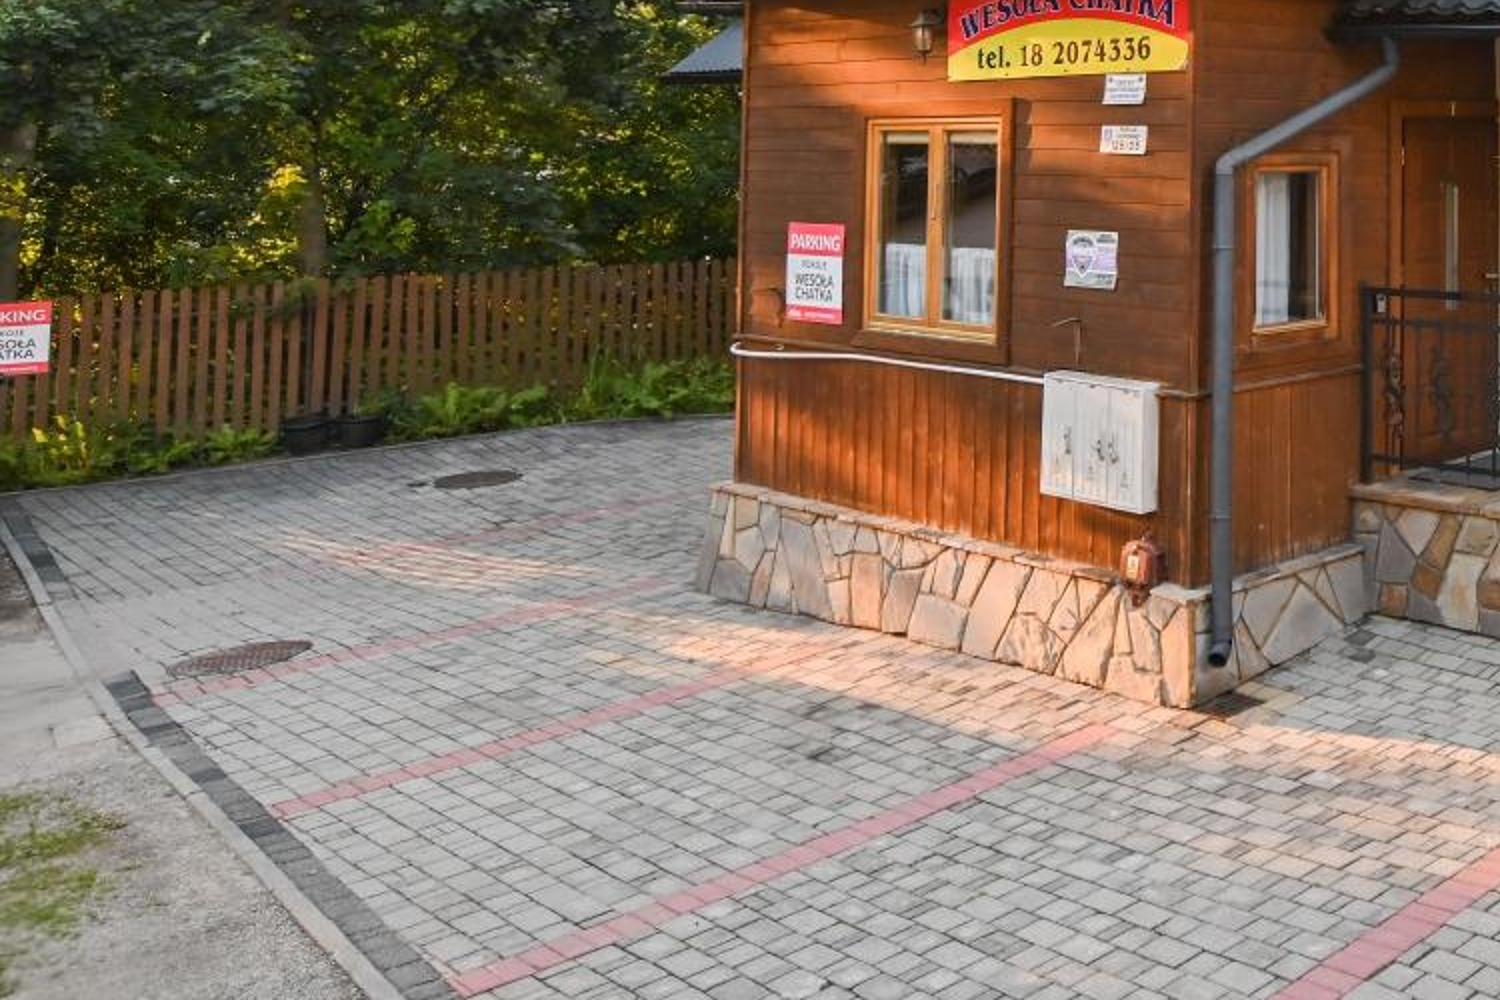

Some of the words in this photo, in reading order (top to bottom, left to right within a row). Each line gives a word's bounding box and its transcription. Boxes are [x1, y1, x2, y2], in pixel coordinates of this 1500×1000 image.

[977, 46, 1011, 69] tel.
[1019, 43, 1044, 67] 18
[1053, 35, 1152, 66] 2074336
[791, 233, 841, 251] PARKING
[795, 286, 832, 302] CHATKA
